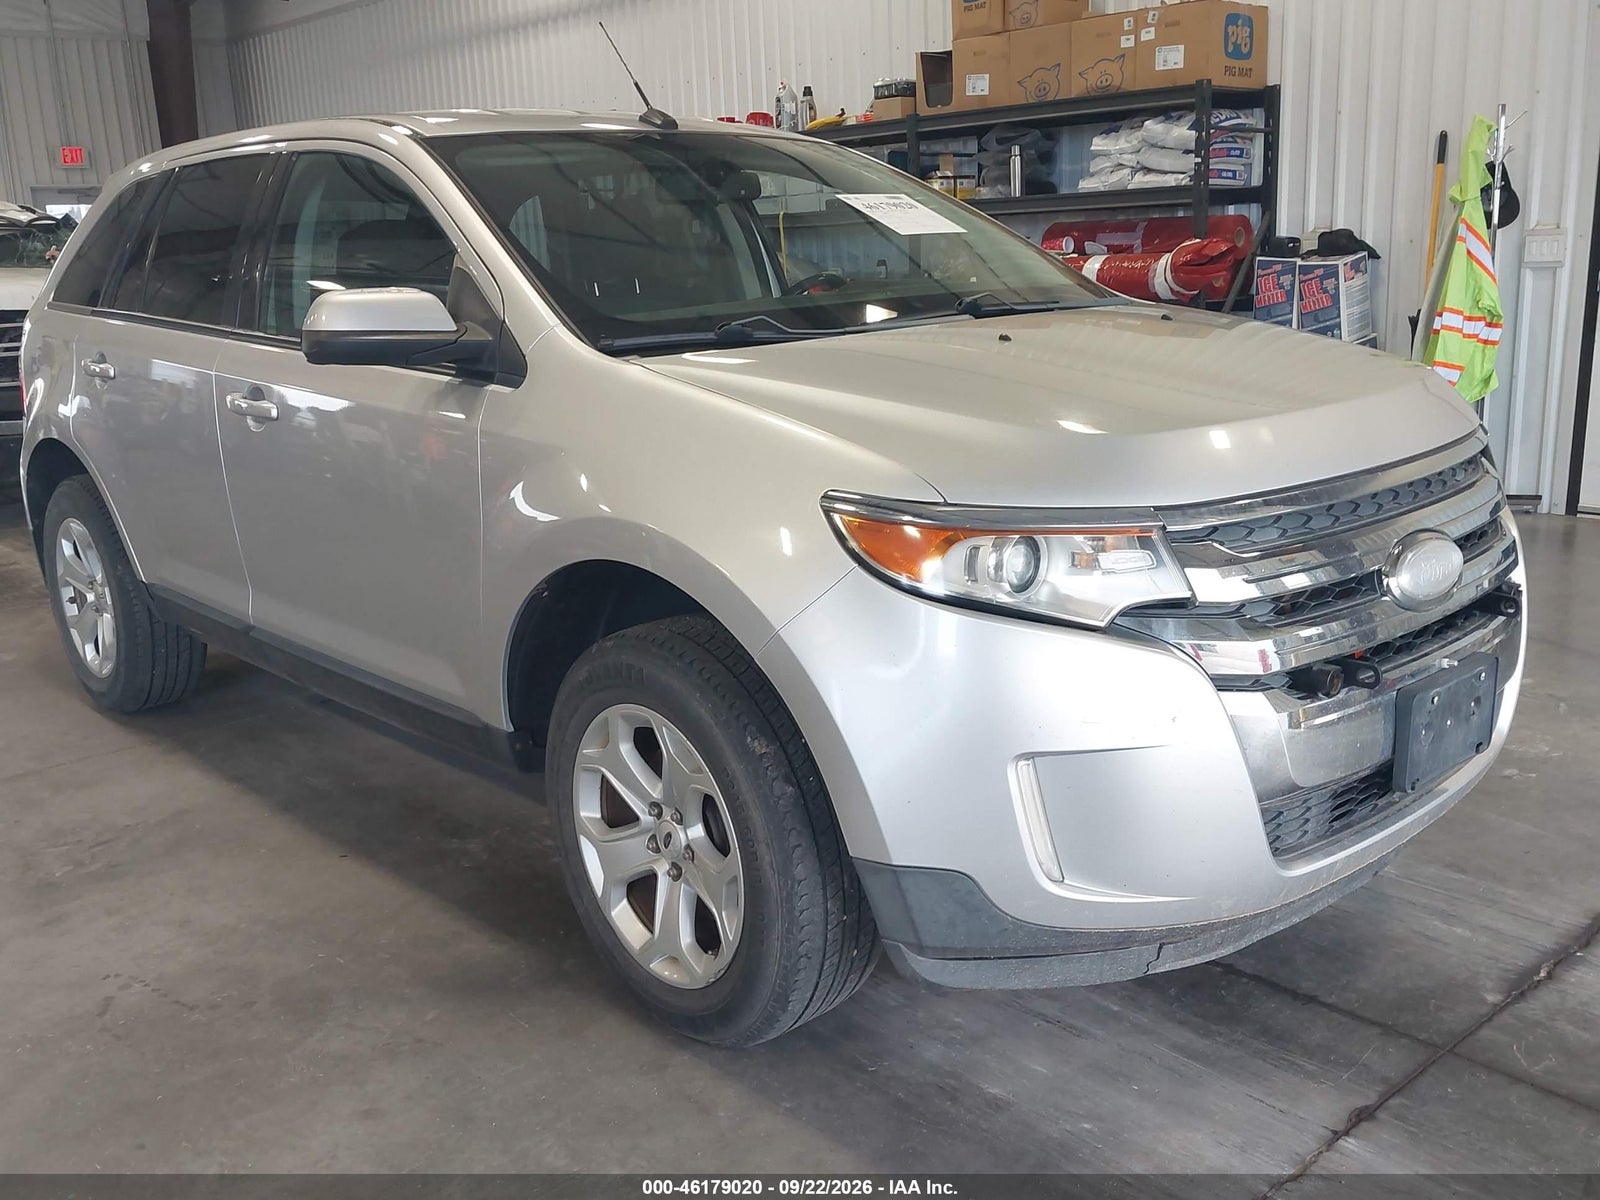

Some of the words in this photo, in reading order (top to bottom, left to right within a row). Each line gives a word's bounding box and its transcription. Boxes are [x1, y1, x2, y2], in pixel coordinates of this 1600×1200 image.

[1228, 19, 1251, 54] pig
[1224, 65, 1237, 77] PIG
[1237, 66, 1253, 78] MAT
[61, 147, 84, 165] EXIT
[1258, 273, 1278, 293] ICE
[1301, 278, 1323, 299] ICE
